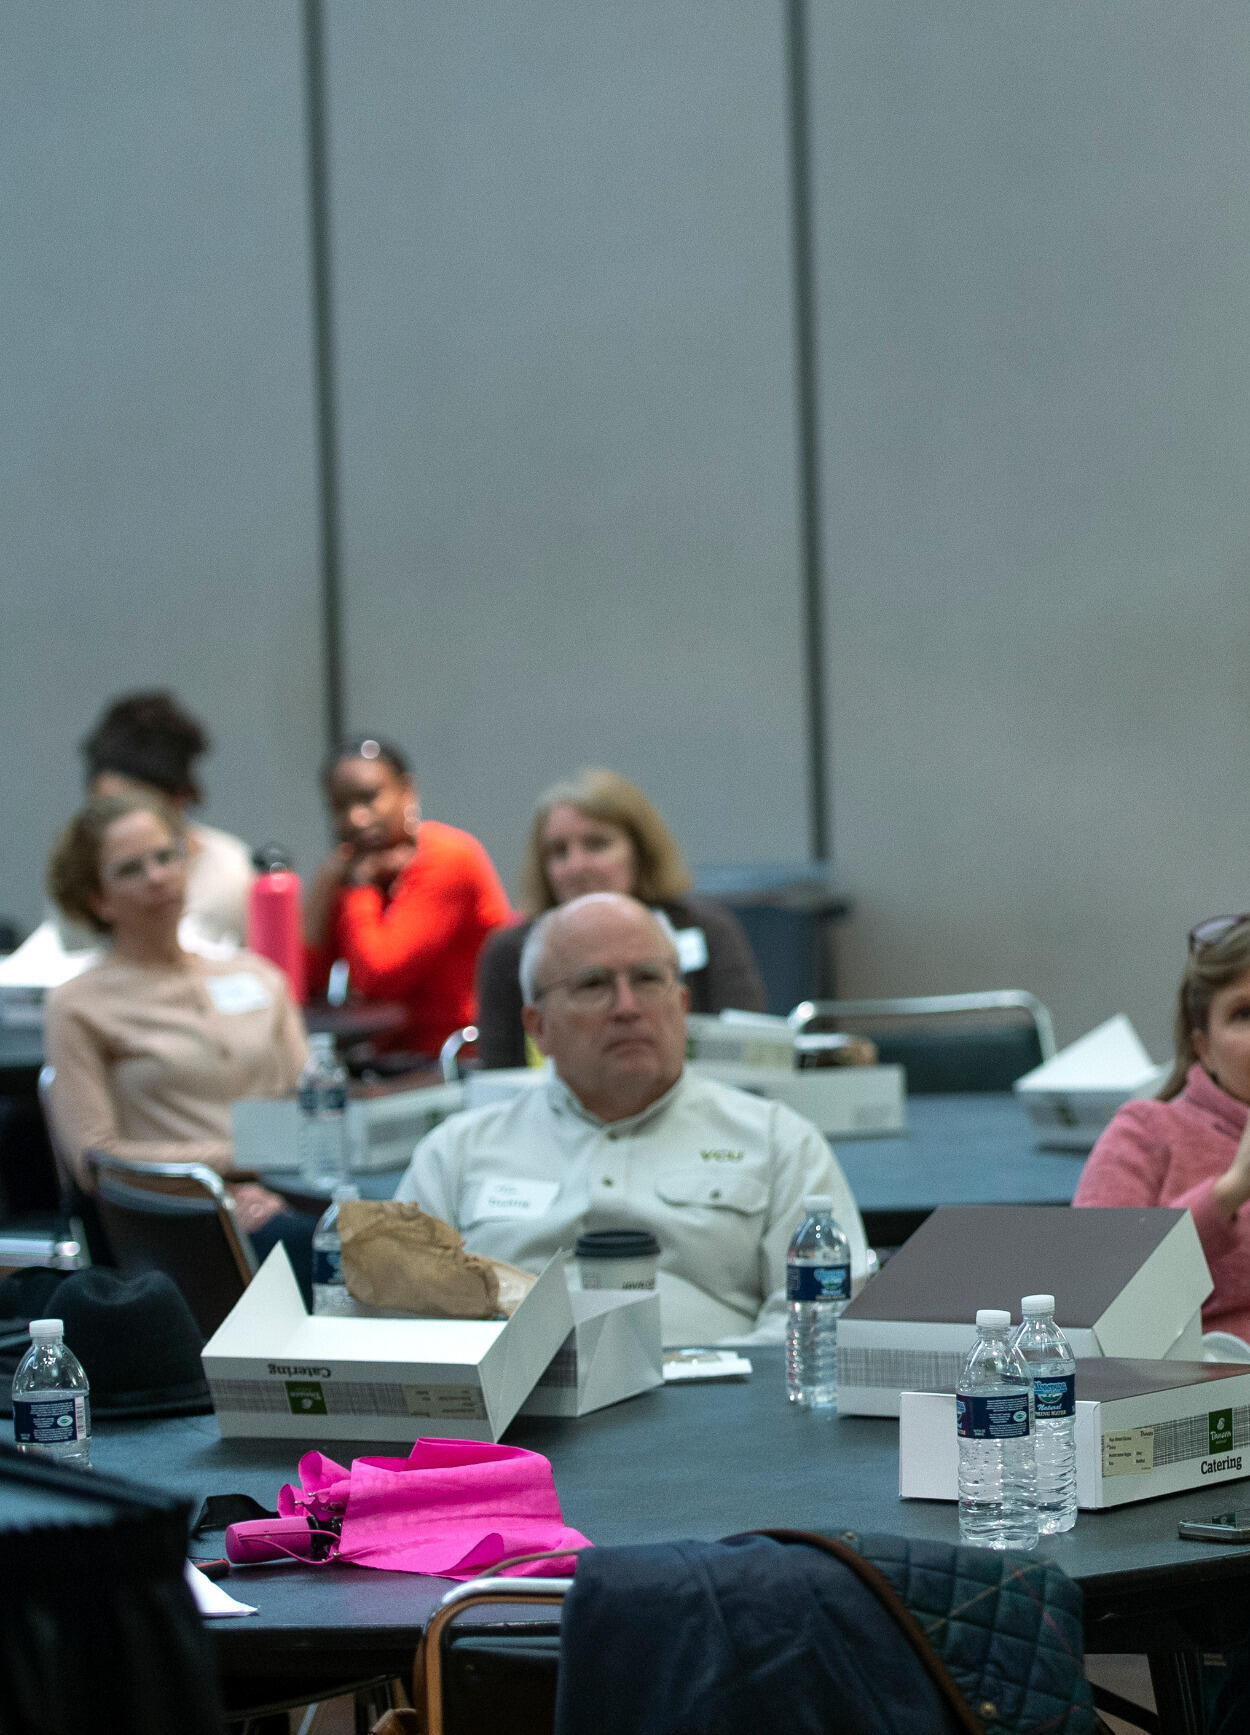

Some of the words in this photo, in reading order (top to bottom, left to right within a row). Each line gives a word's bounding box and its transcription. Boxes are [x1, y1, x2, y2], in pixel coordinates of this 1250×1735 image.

[700, 1150, 744, 1161] VCU
[267, 1364, 331, 1379] Catering
[1200, 1456, 1242, 1475] Catering
